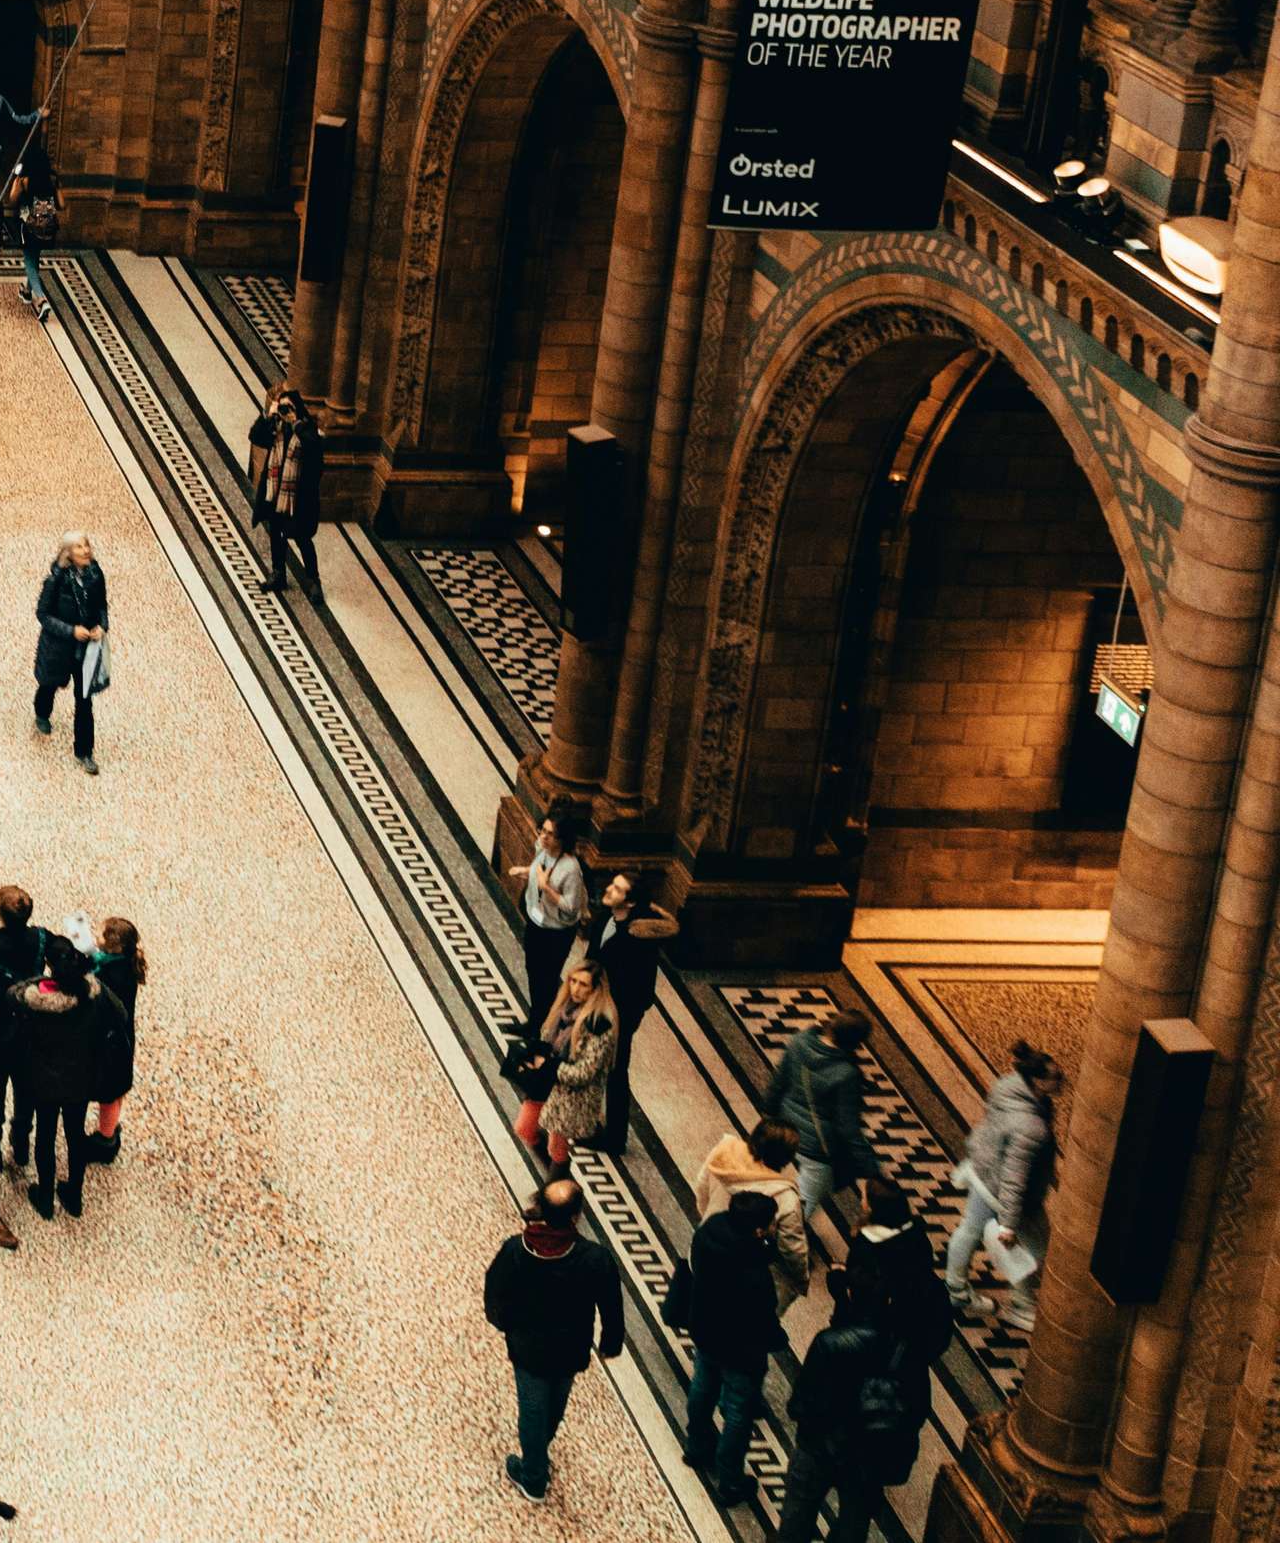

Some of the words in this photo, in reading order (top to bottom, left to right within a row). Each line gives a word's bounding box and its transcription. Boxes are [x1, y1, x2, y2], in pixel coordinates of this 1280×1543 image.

[751, 13, 961, 41] PHOTOGRAPHER
[748, 42, 778, 65] OF
[785, 43, 829, 67] THE
[835, 45, 892, 68] YEAR
[723, 195, 820, 217] LUMIX
